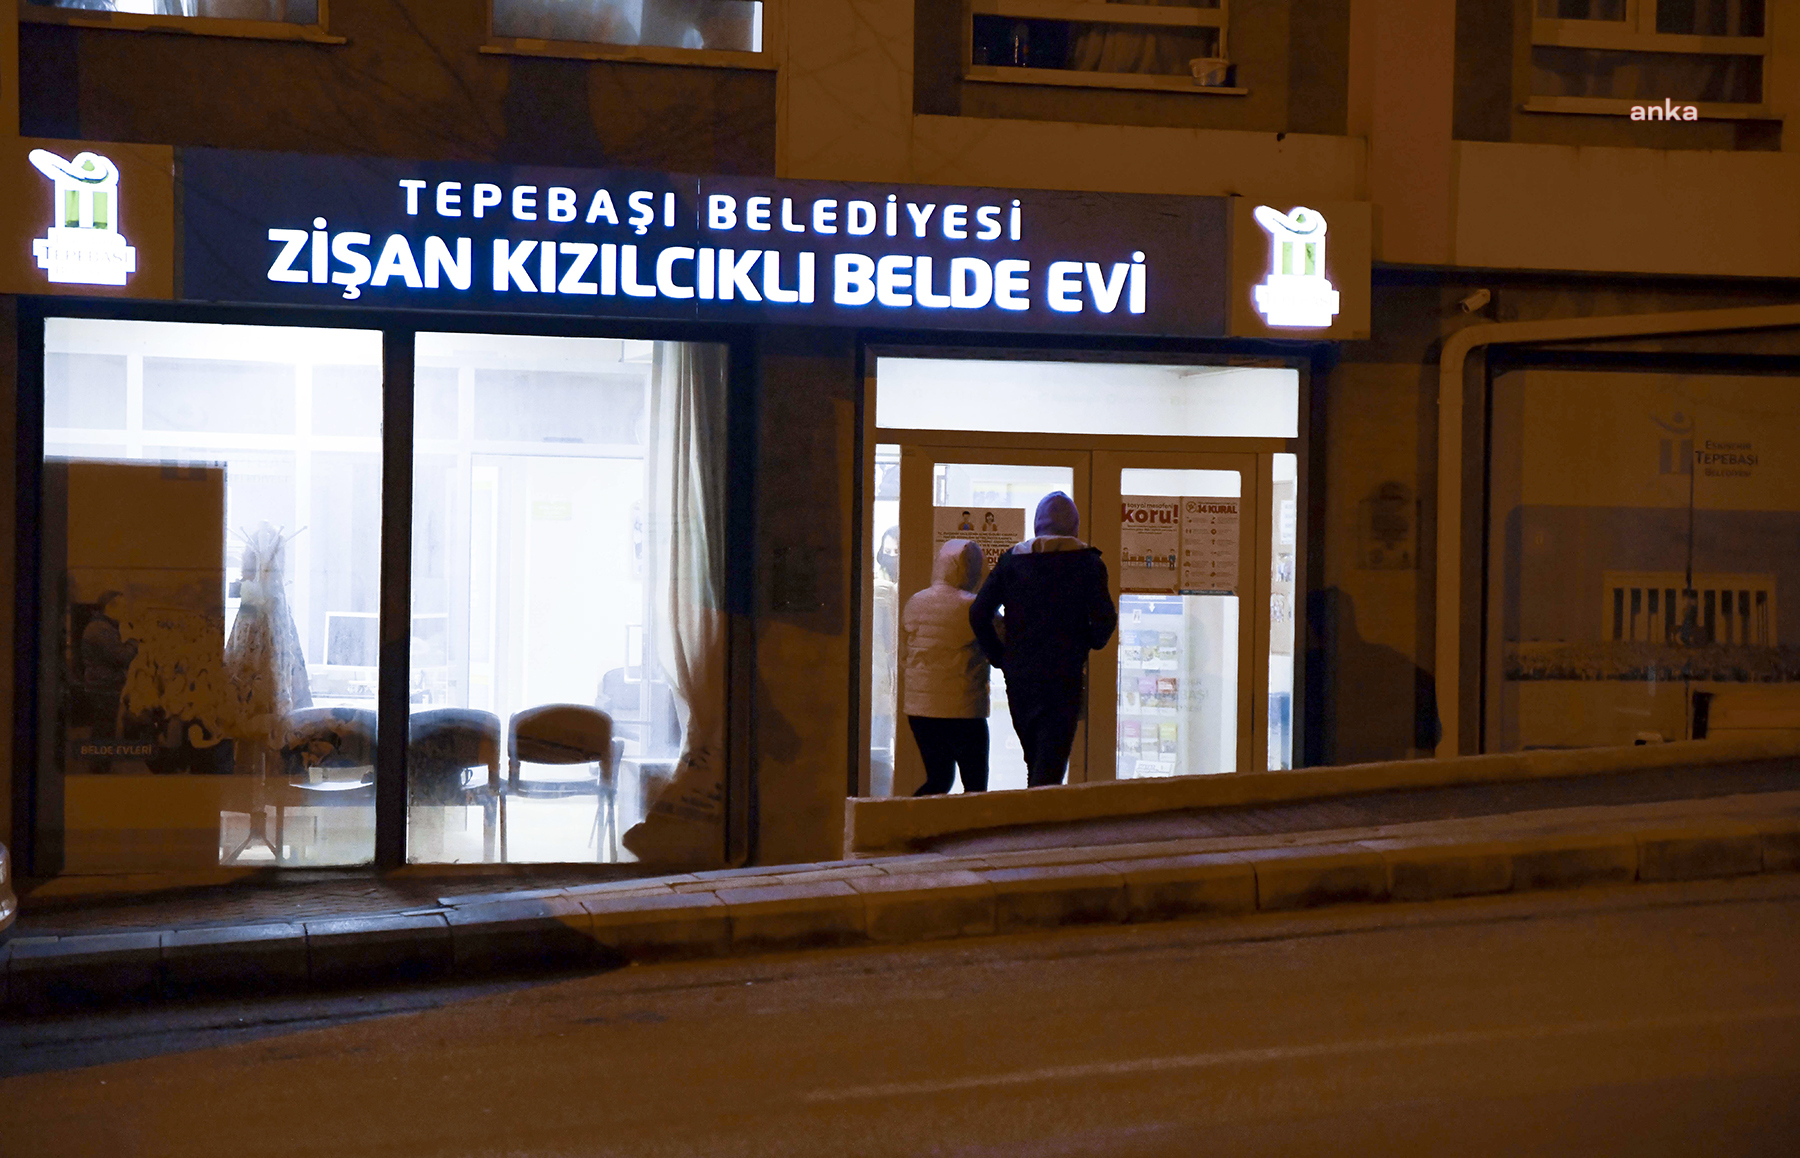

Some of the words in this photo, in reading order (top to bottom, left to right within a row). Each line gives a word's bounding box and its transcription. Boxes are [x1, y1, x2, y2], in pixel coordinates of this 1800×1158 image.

[398, 179, 675, 235] TEPEBAŞI
[708, 193, 1021, 241] BELEDİYESİ
[267, 216, 472, 300] ZİŞAN
[492, 238, 815, 304] KIZILCIKLI
[833, 253, 1030, 311] BELDE
[1047, 250, 1146, 314] EVİ
[1695, 450, 1759, 466] TEPEBAŞI
[1120, 502, 1179, 525] koru!
[1208, 505, 1238, 515] KURAL
[80, 745, 113, 755] BELDE
[116, 743, 152, 755] EVLERİ
